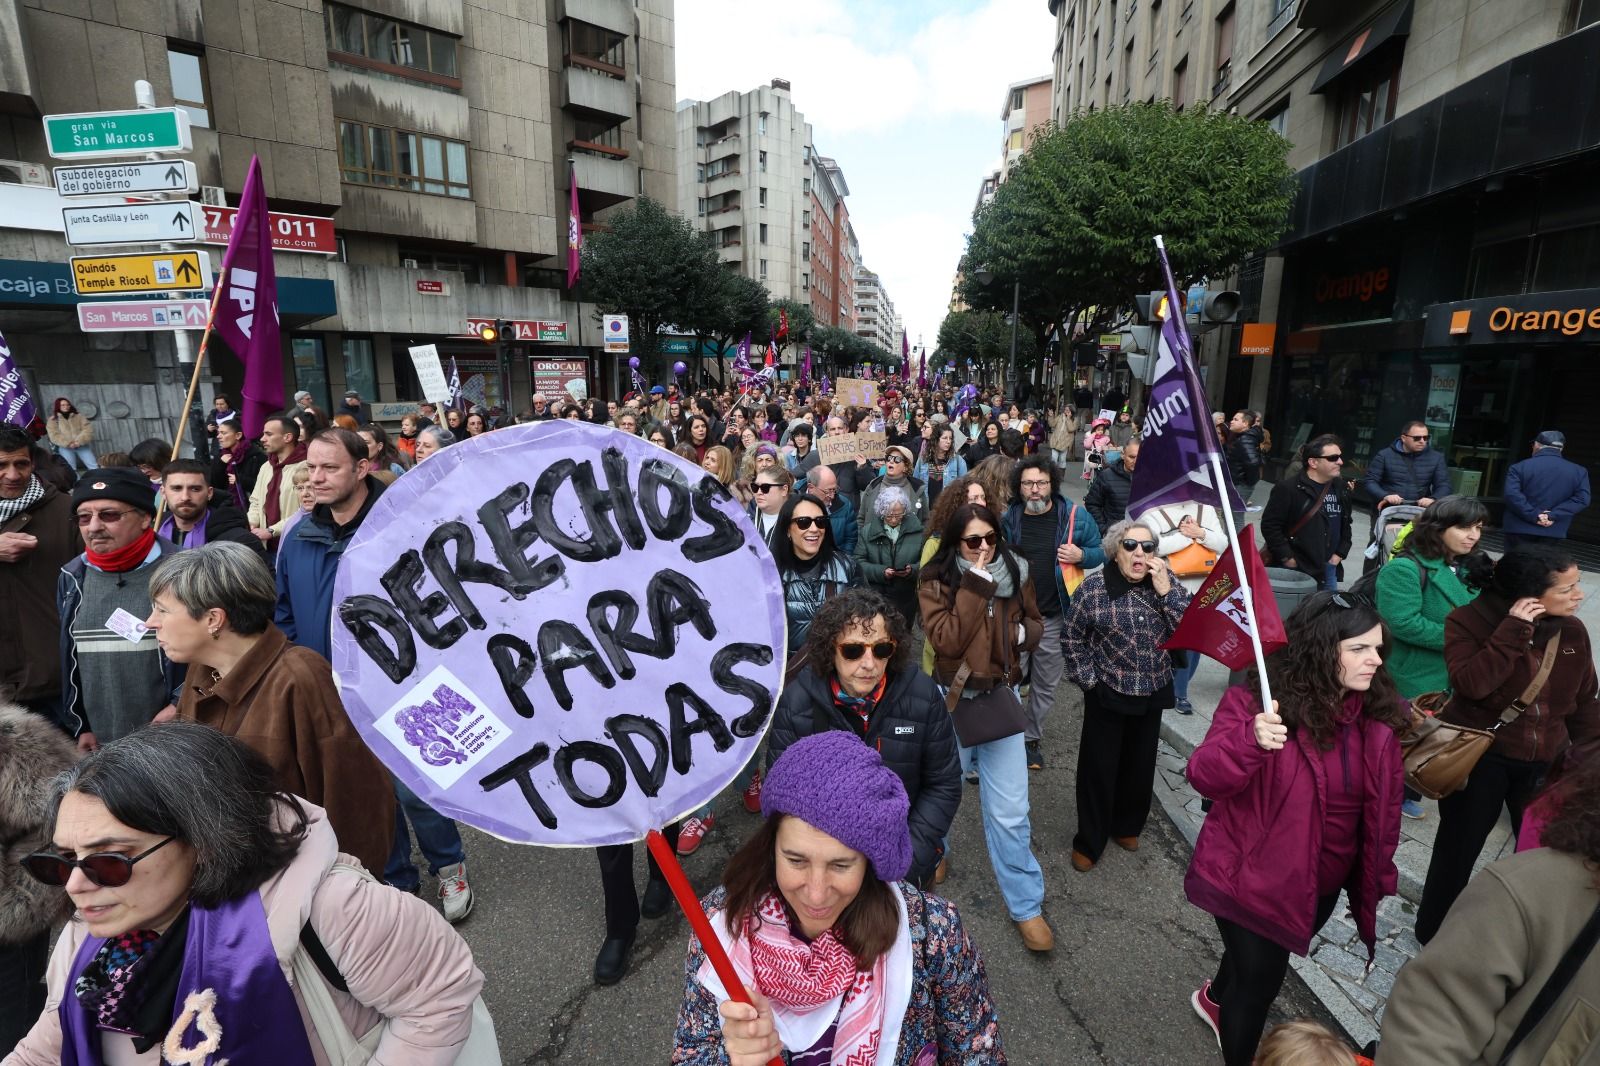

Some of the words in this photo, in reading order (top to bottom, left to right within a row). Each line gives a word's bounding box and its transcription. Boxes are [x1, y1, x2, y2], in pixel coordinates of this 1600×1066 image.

[71, 122, 94, 134] gran
[73, 134, 98, 147] San
[105, 132, 155, 145] Marcos
[61, 166, 141, 182] subdelegación
[63, 179, 80, 192] del
[82, 178, 131, 193] gobierno
[70, 214, 91, 225] junta
[92, 213, 122, 223] Castilla
[123, 214, 128, 223] y
[130, 211, 149, 221] León
[77, 261, 117, 275] Quindós
[79, 276, 115, 290] Temple
[120, 275, 150, 287] Riosol
[1315, 267, 1389, 302] Orange
[86, 311, 106, 323] San
[112, 311, 149, 322] Marcos
[1489, 307, 1600, 335] Orange
[1242, 345, 1270, 354] orange
[338, 446, 746, 684] DERECHOS
[486, 568, 718, 719] PARA
[454, 714, 485, 741] Feminismo
[460, 732, 475, 746] para
[465, 725, 493, 750] cambiarlo
[478, 642, 774, 830] TODAS
[470, 741, 485, 754] todo
